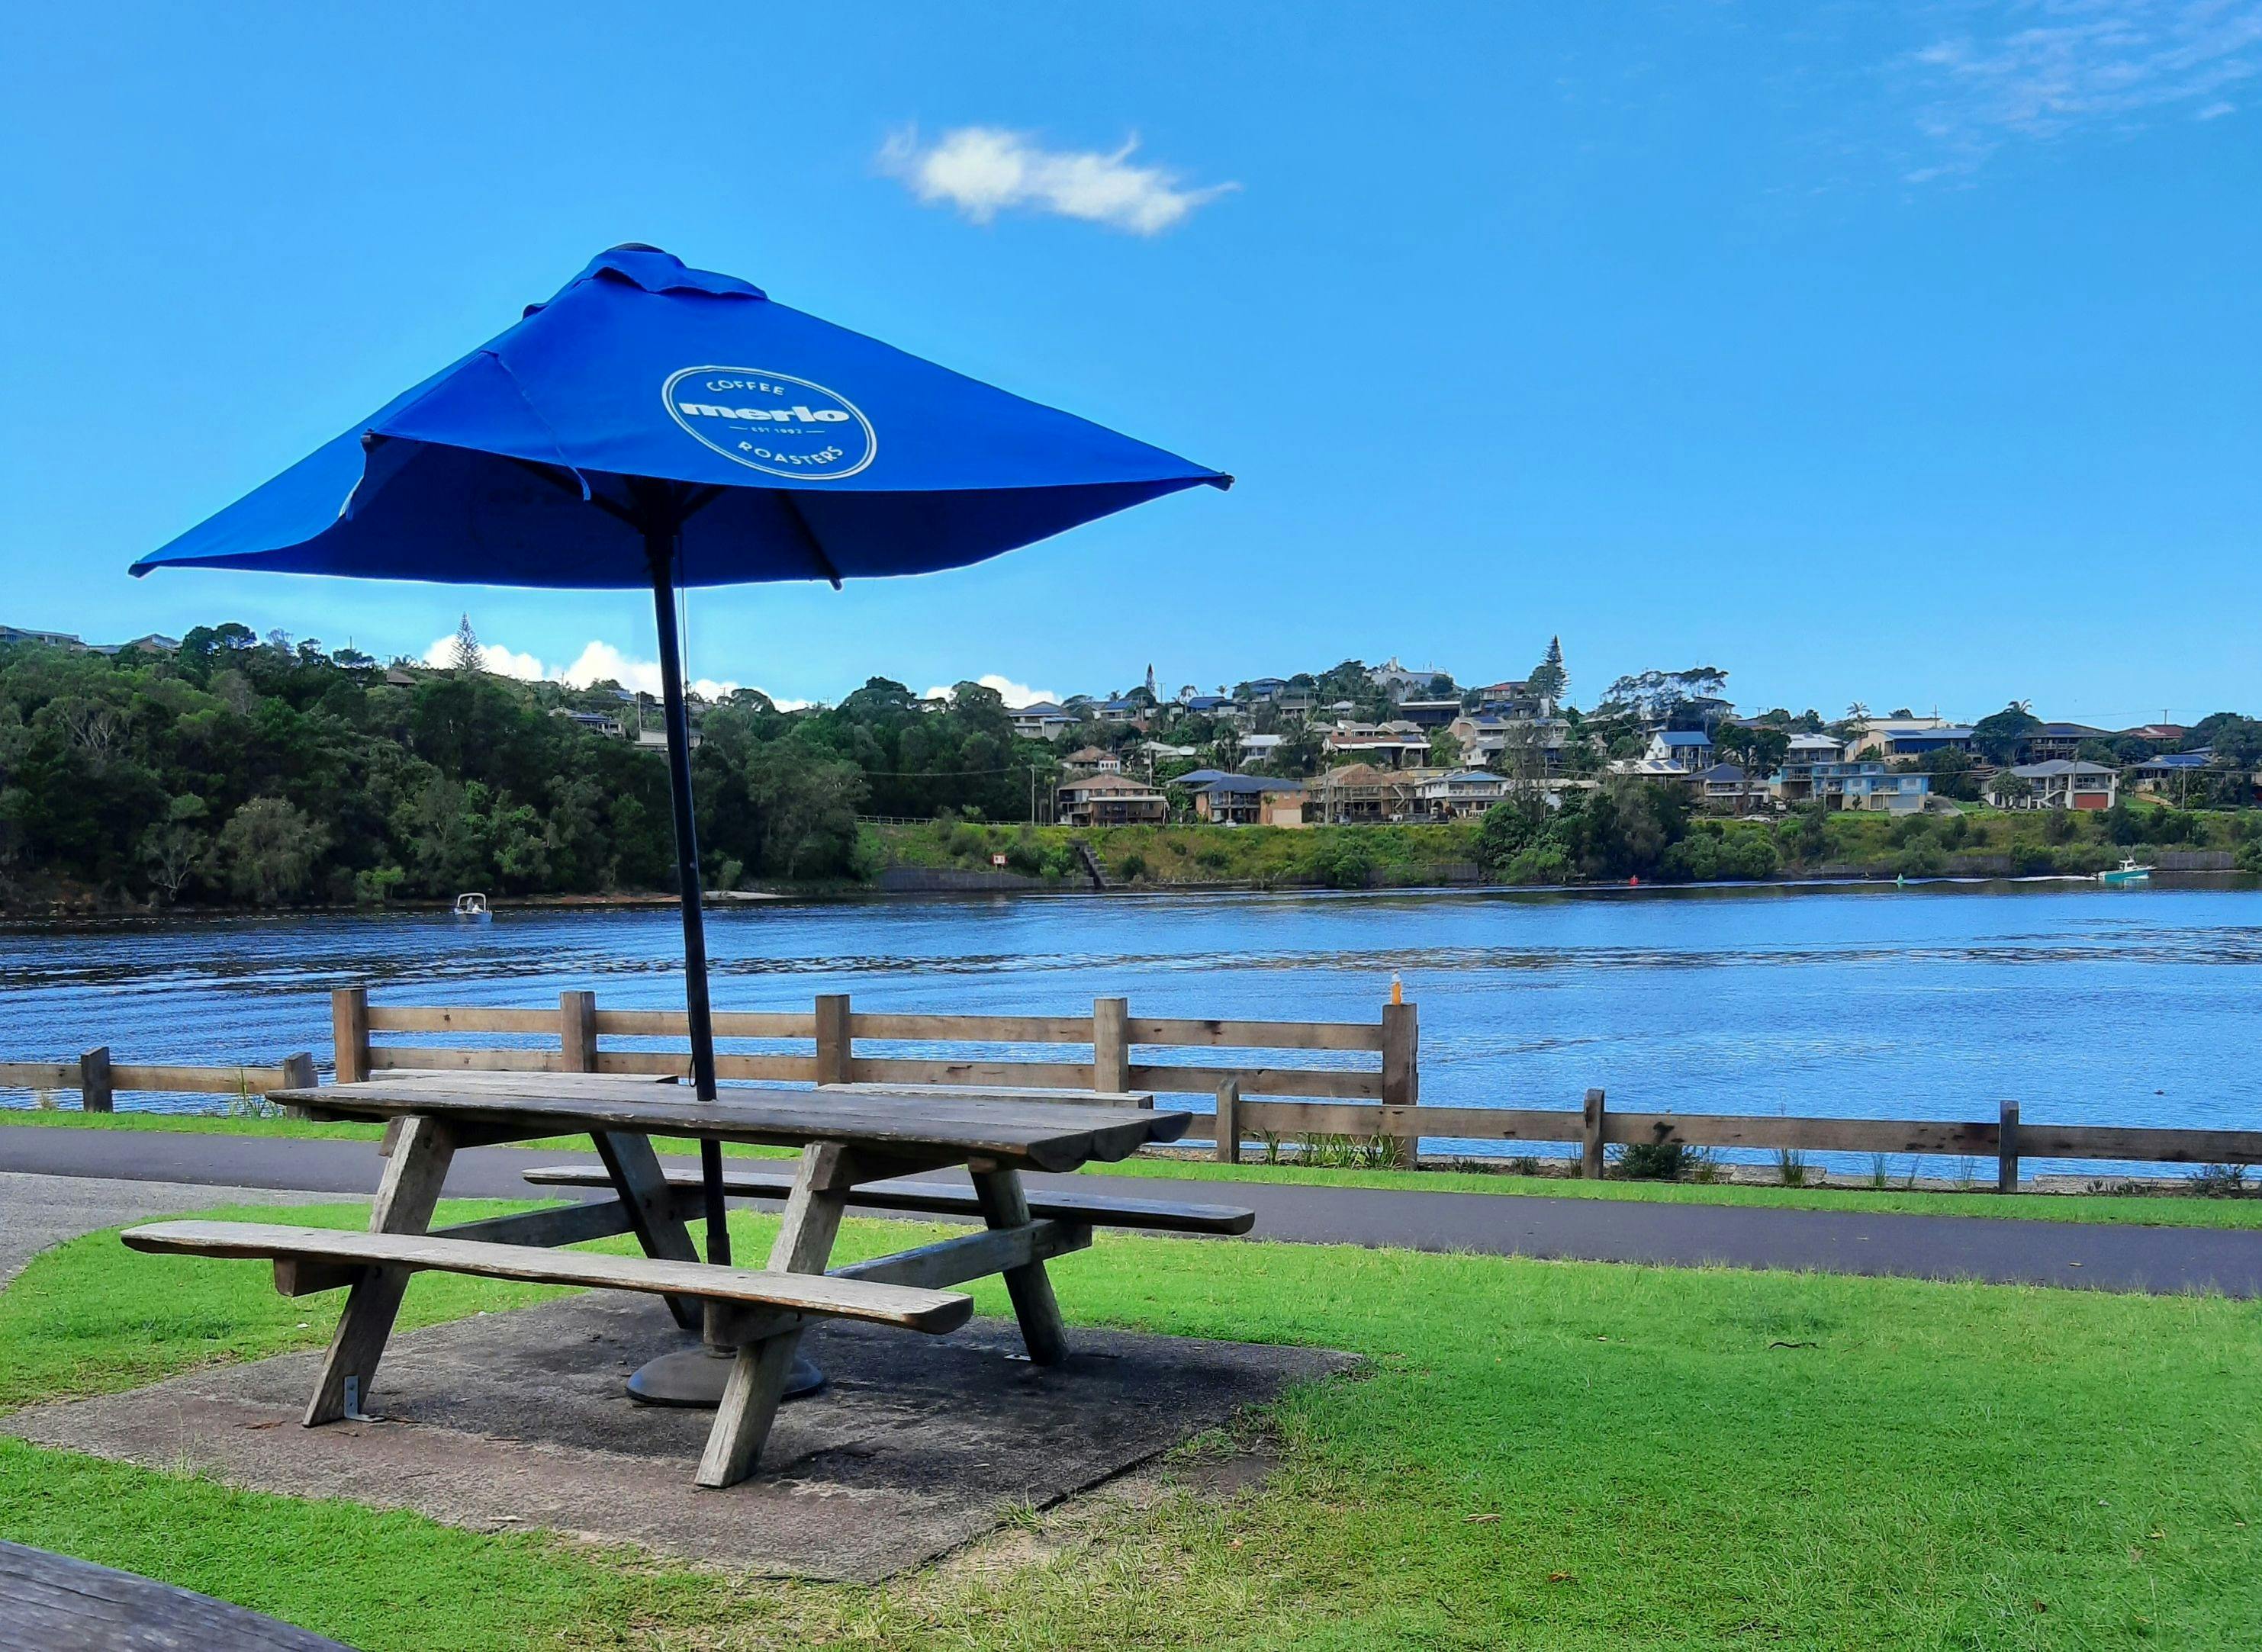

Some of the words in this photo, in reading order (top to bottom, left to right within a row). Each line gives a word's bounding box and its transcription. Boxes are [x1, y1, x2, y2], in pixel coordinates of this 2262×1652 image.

[706, 380, 785, 396] COFFEE
[679, 402, 851, 422] merlo
[738, 441, 844, 465] ROASTERS
